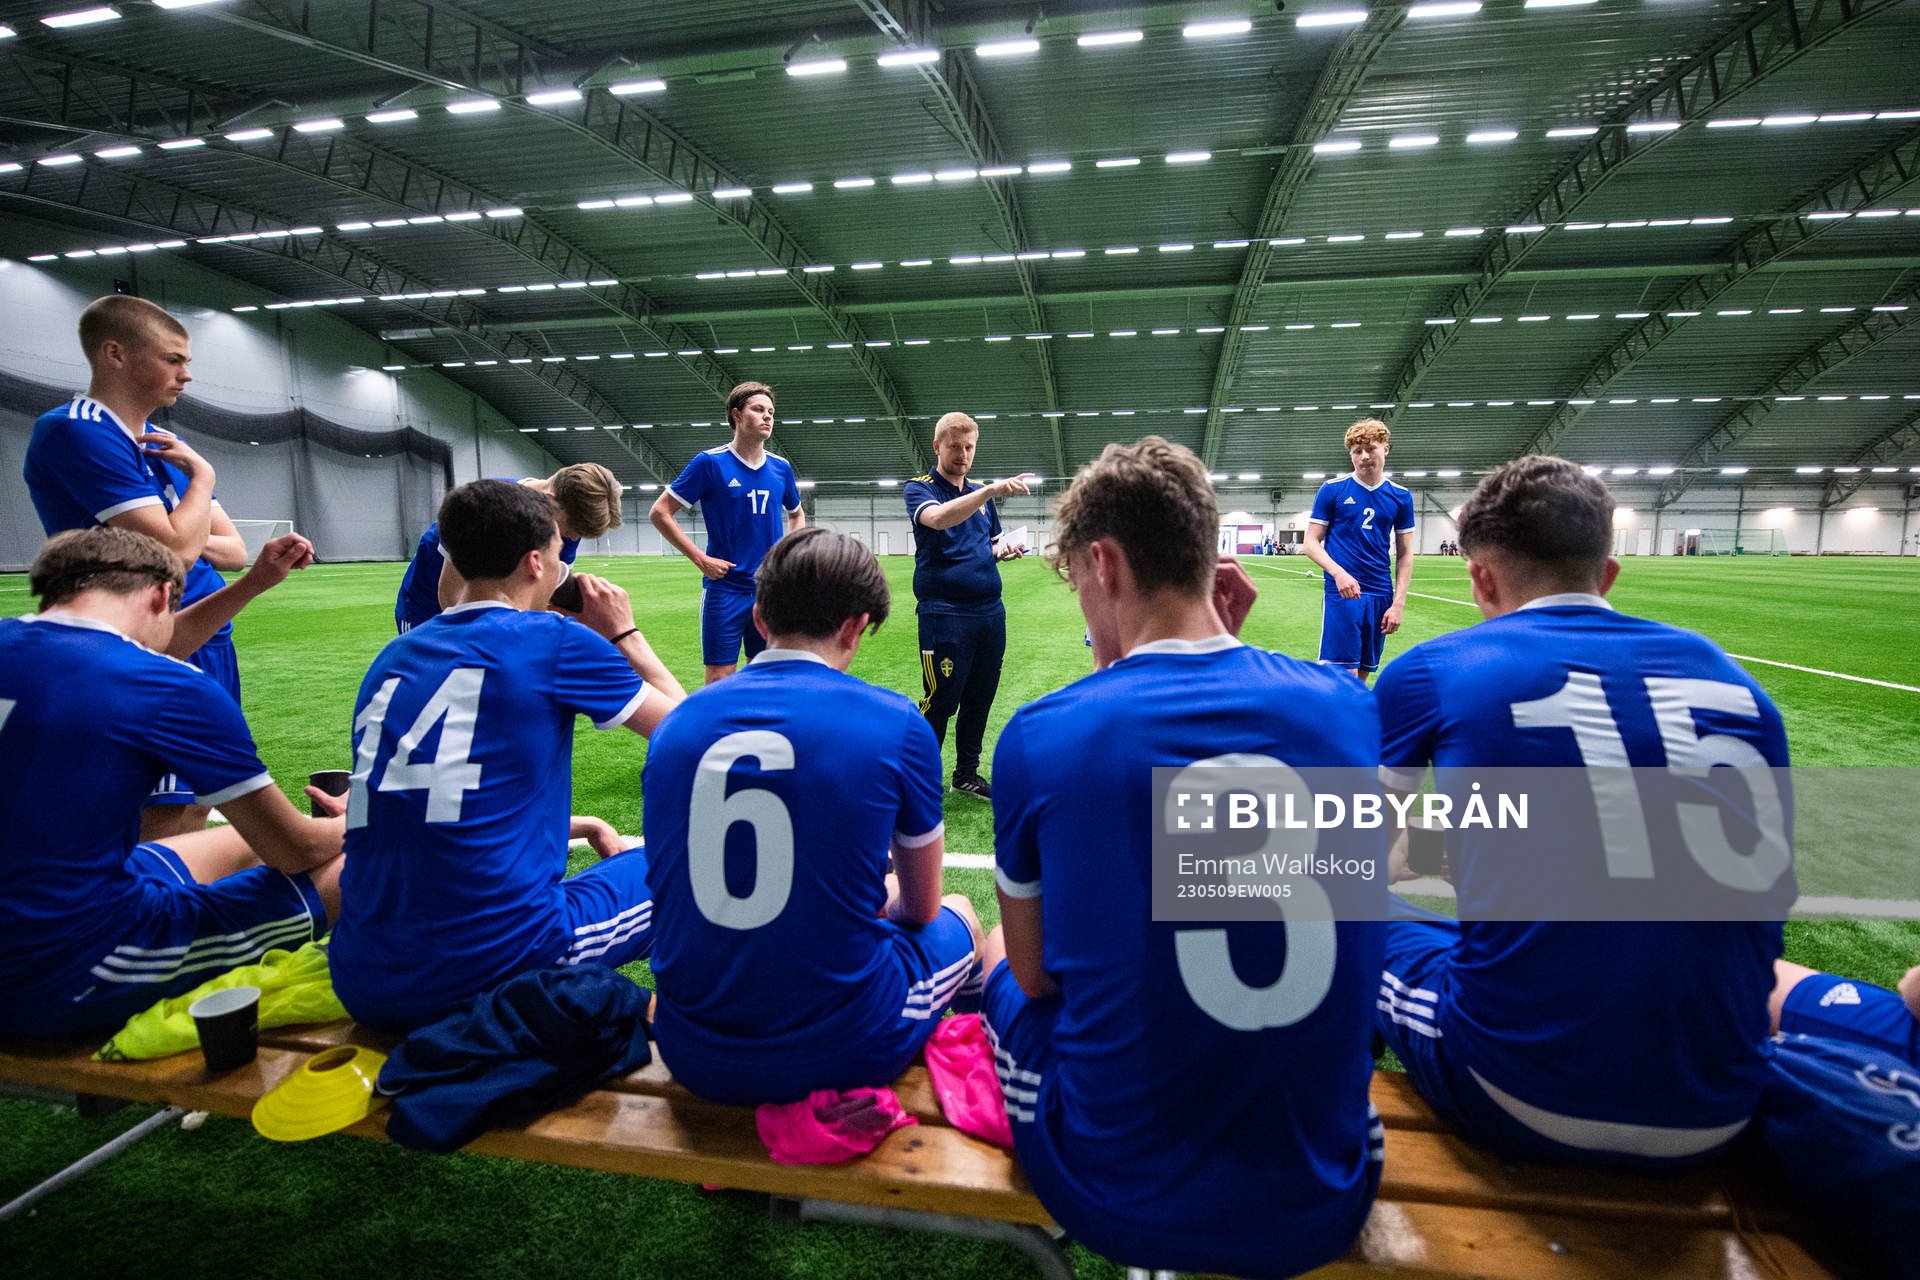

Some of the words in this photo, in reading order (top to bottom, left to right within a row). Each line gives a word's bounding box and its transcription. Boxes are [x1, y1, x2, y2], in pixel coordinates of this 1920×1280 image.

[747, 489, 770, 514] 17
[1361, 507, 1375, 530] 2
[346, 668, 486, 830] 14
[687, 730, 795, 930] 6
[1510, 671, 1792, 892] 15
[1164, 753, 1338, 1031] 3
